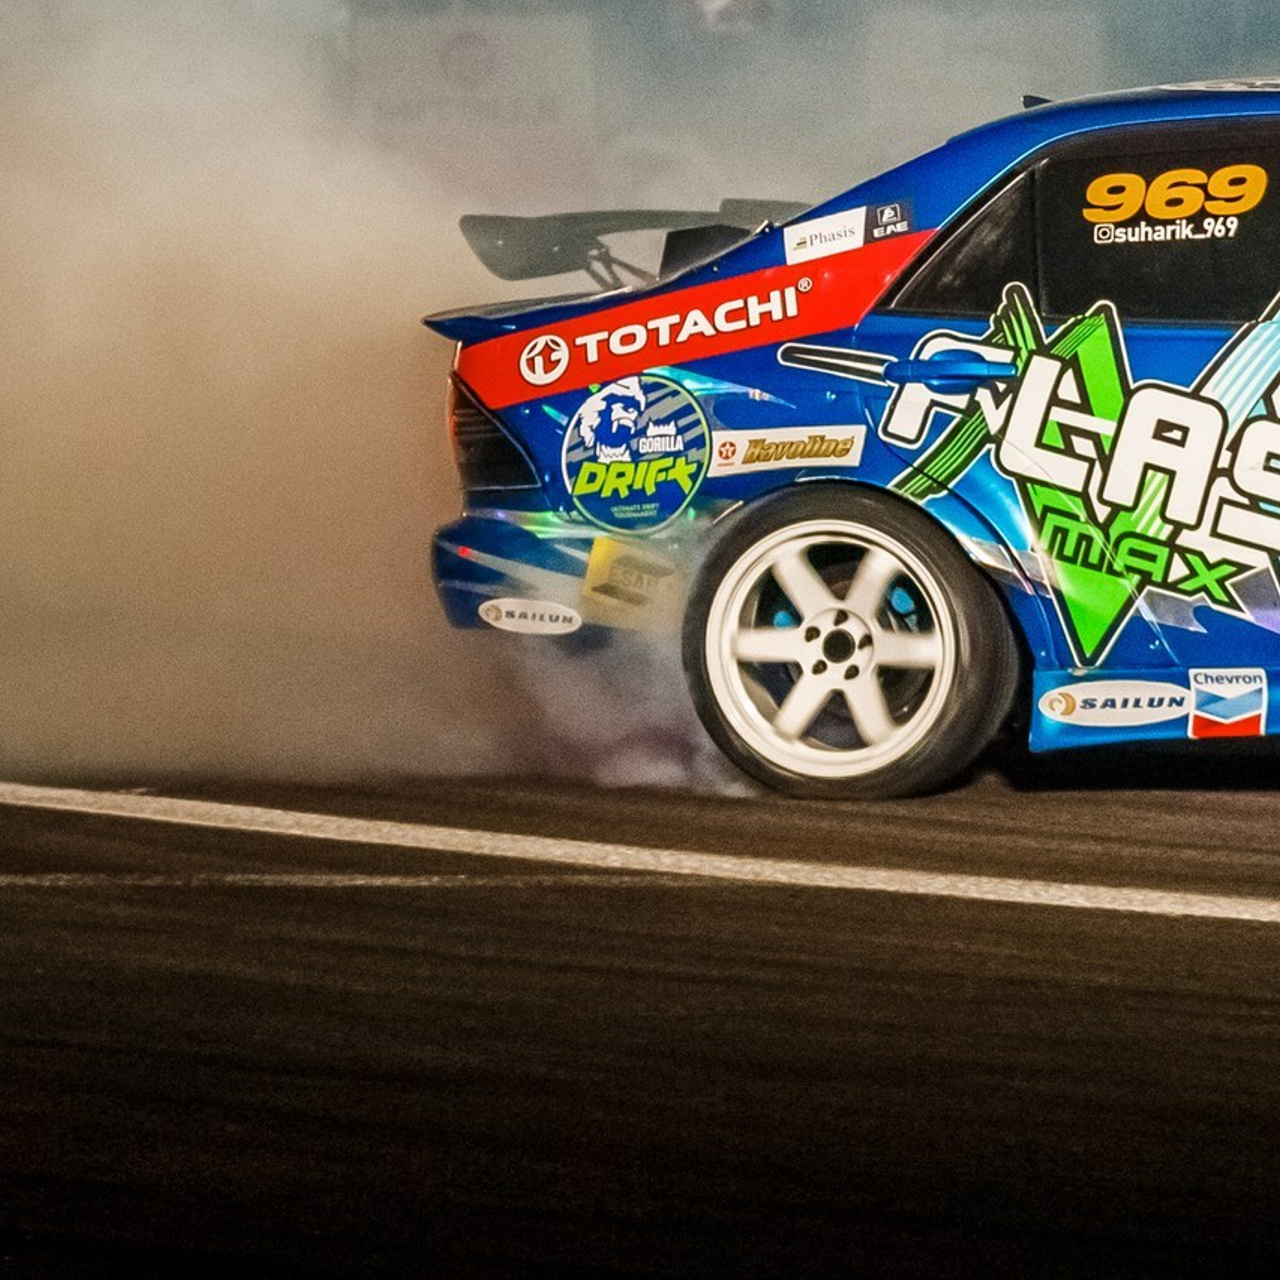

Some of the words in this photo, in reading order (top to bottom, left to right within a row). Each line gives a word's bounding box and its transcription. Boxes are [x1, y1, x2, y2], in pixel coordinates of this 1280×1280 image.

[1082, 164, 1268, 223] 969
[809, 225, 856, 246] Phasis
[1114, 216, 1239, 243] suharik_969
[574, 286, 799, 364] TOTACHI
[638, 435, 684, 453] GORILLA
[742, 435, 855, 464] Havoline
[572, 456, 698, 498] DRIFT
[1039, 514, 1237, 604] MAX
[504, 609, 574, 625] SAILUN
[1193, 672, 1263, 686] Chevron
[1080, 696, 1187, 710] SAILUN
